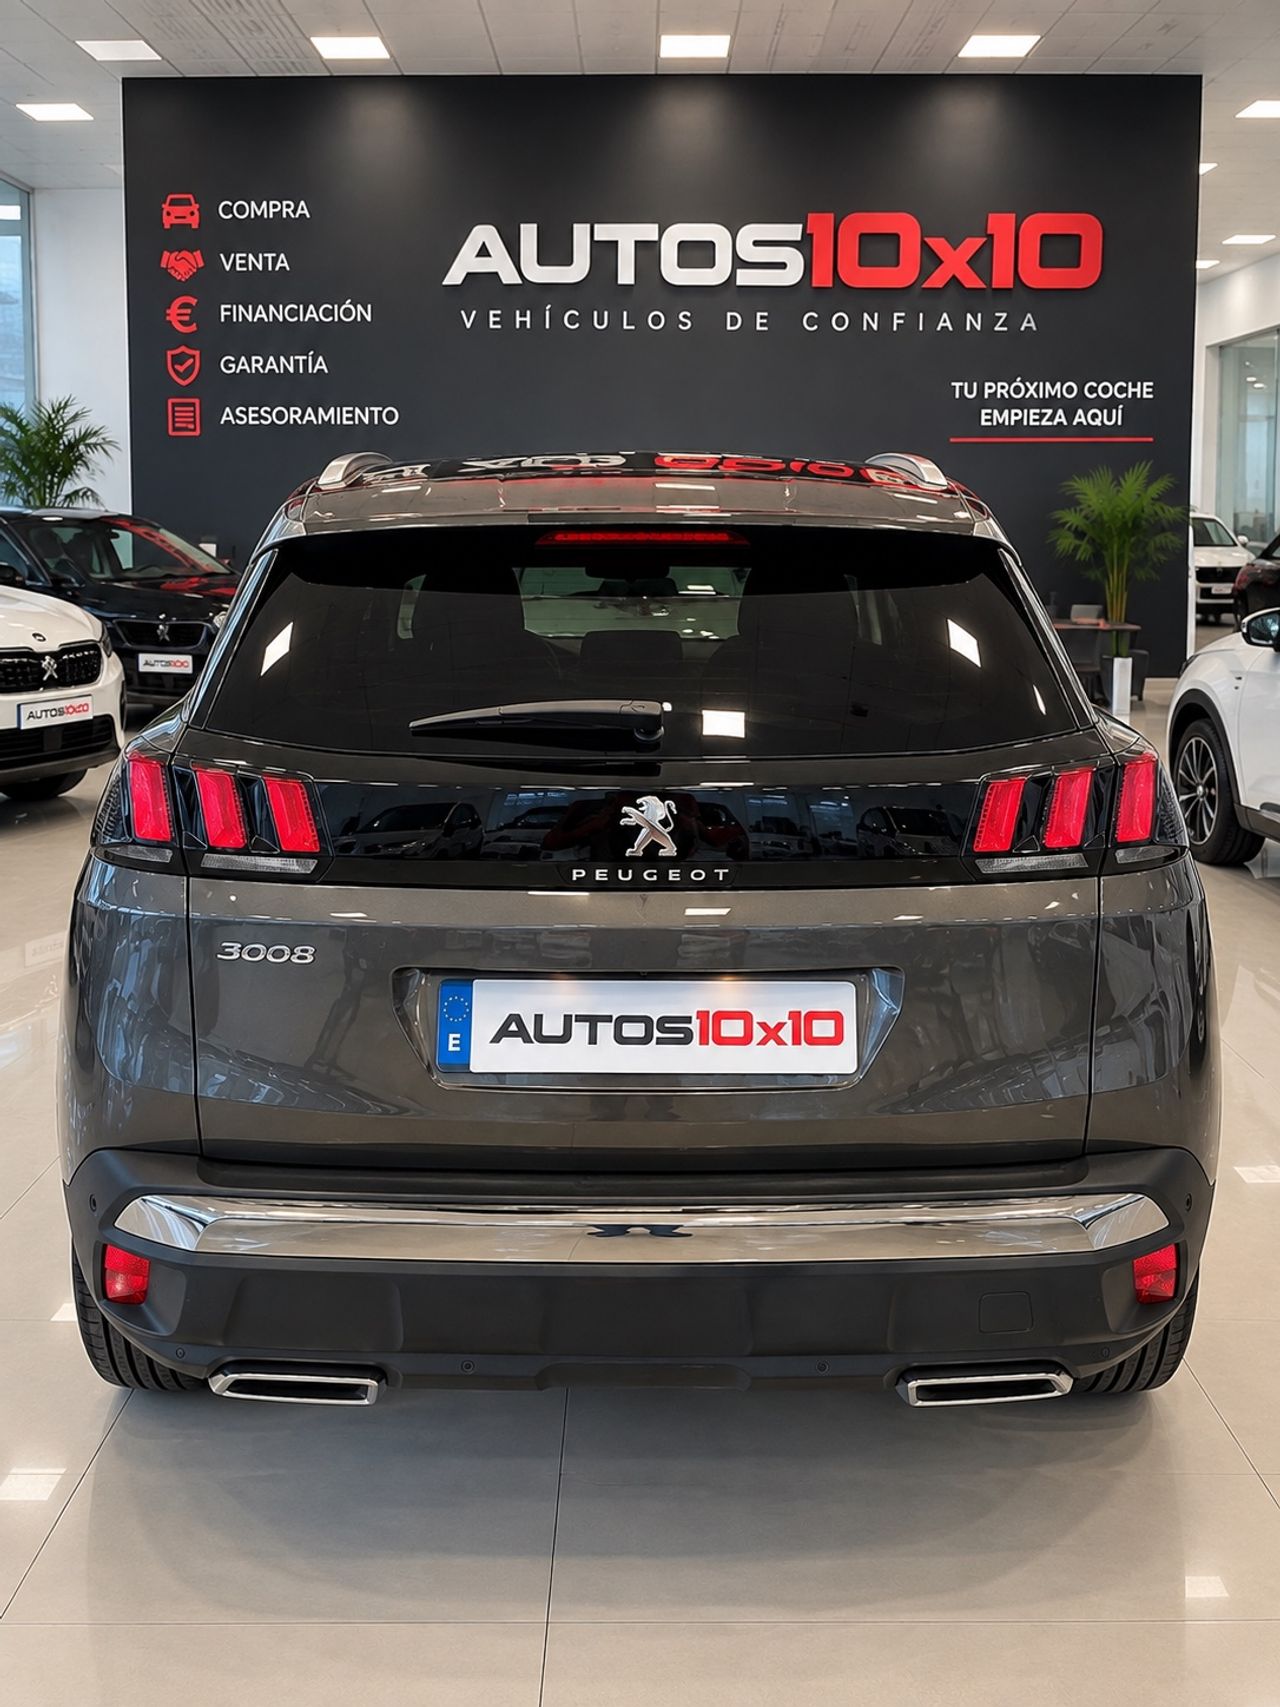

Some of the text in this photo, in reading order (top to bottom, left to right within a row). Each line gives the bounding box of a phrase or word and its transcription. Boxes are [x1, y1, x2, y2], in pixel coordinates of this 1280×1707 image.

[218, 199, 311, 220] COMPRA
[219, 252, 290, 272] VENTA
[442, 211, 1104, 289] AUTOS10x10
[219, 298, 373, 323] FINANCIACIÓN
[460, 304, 1039, 332] VEHÍCULOS DE CONFIANZA
[219, 350, 329, 374] GARANTÍA
[950, 376, 1154, 400] TU PRÓXIMO COCHE
[219, 406, 400, 426] ASESORAMIENTO
[980, 404, 1124, 428] EMPIEZA AQUÍ
[572, 868, 730, 881] PEUGEOT
[216, 942, 316, 965] 3008
[448, 1009, 845, 1052] E AUTOS10x10
